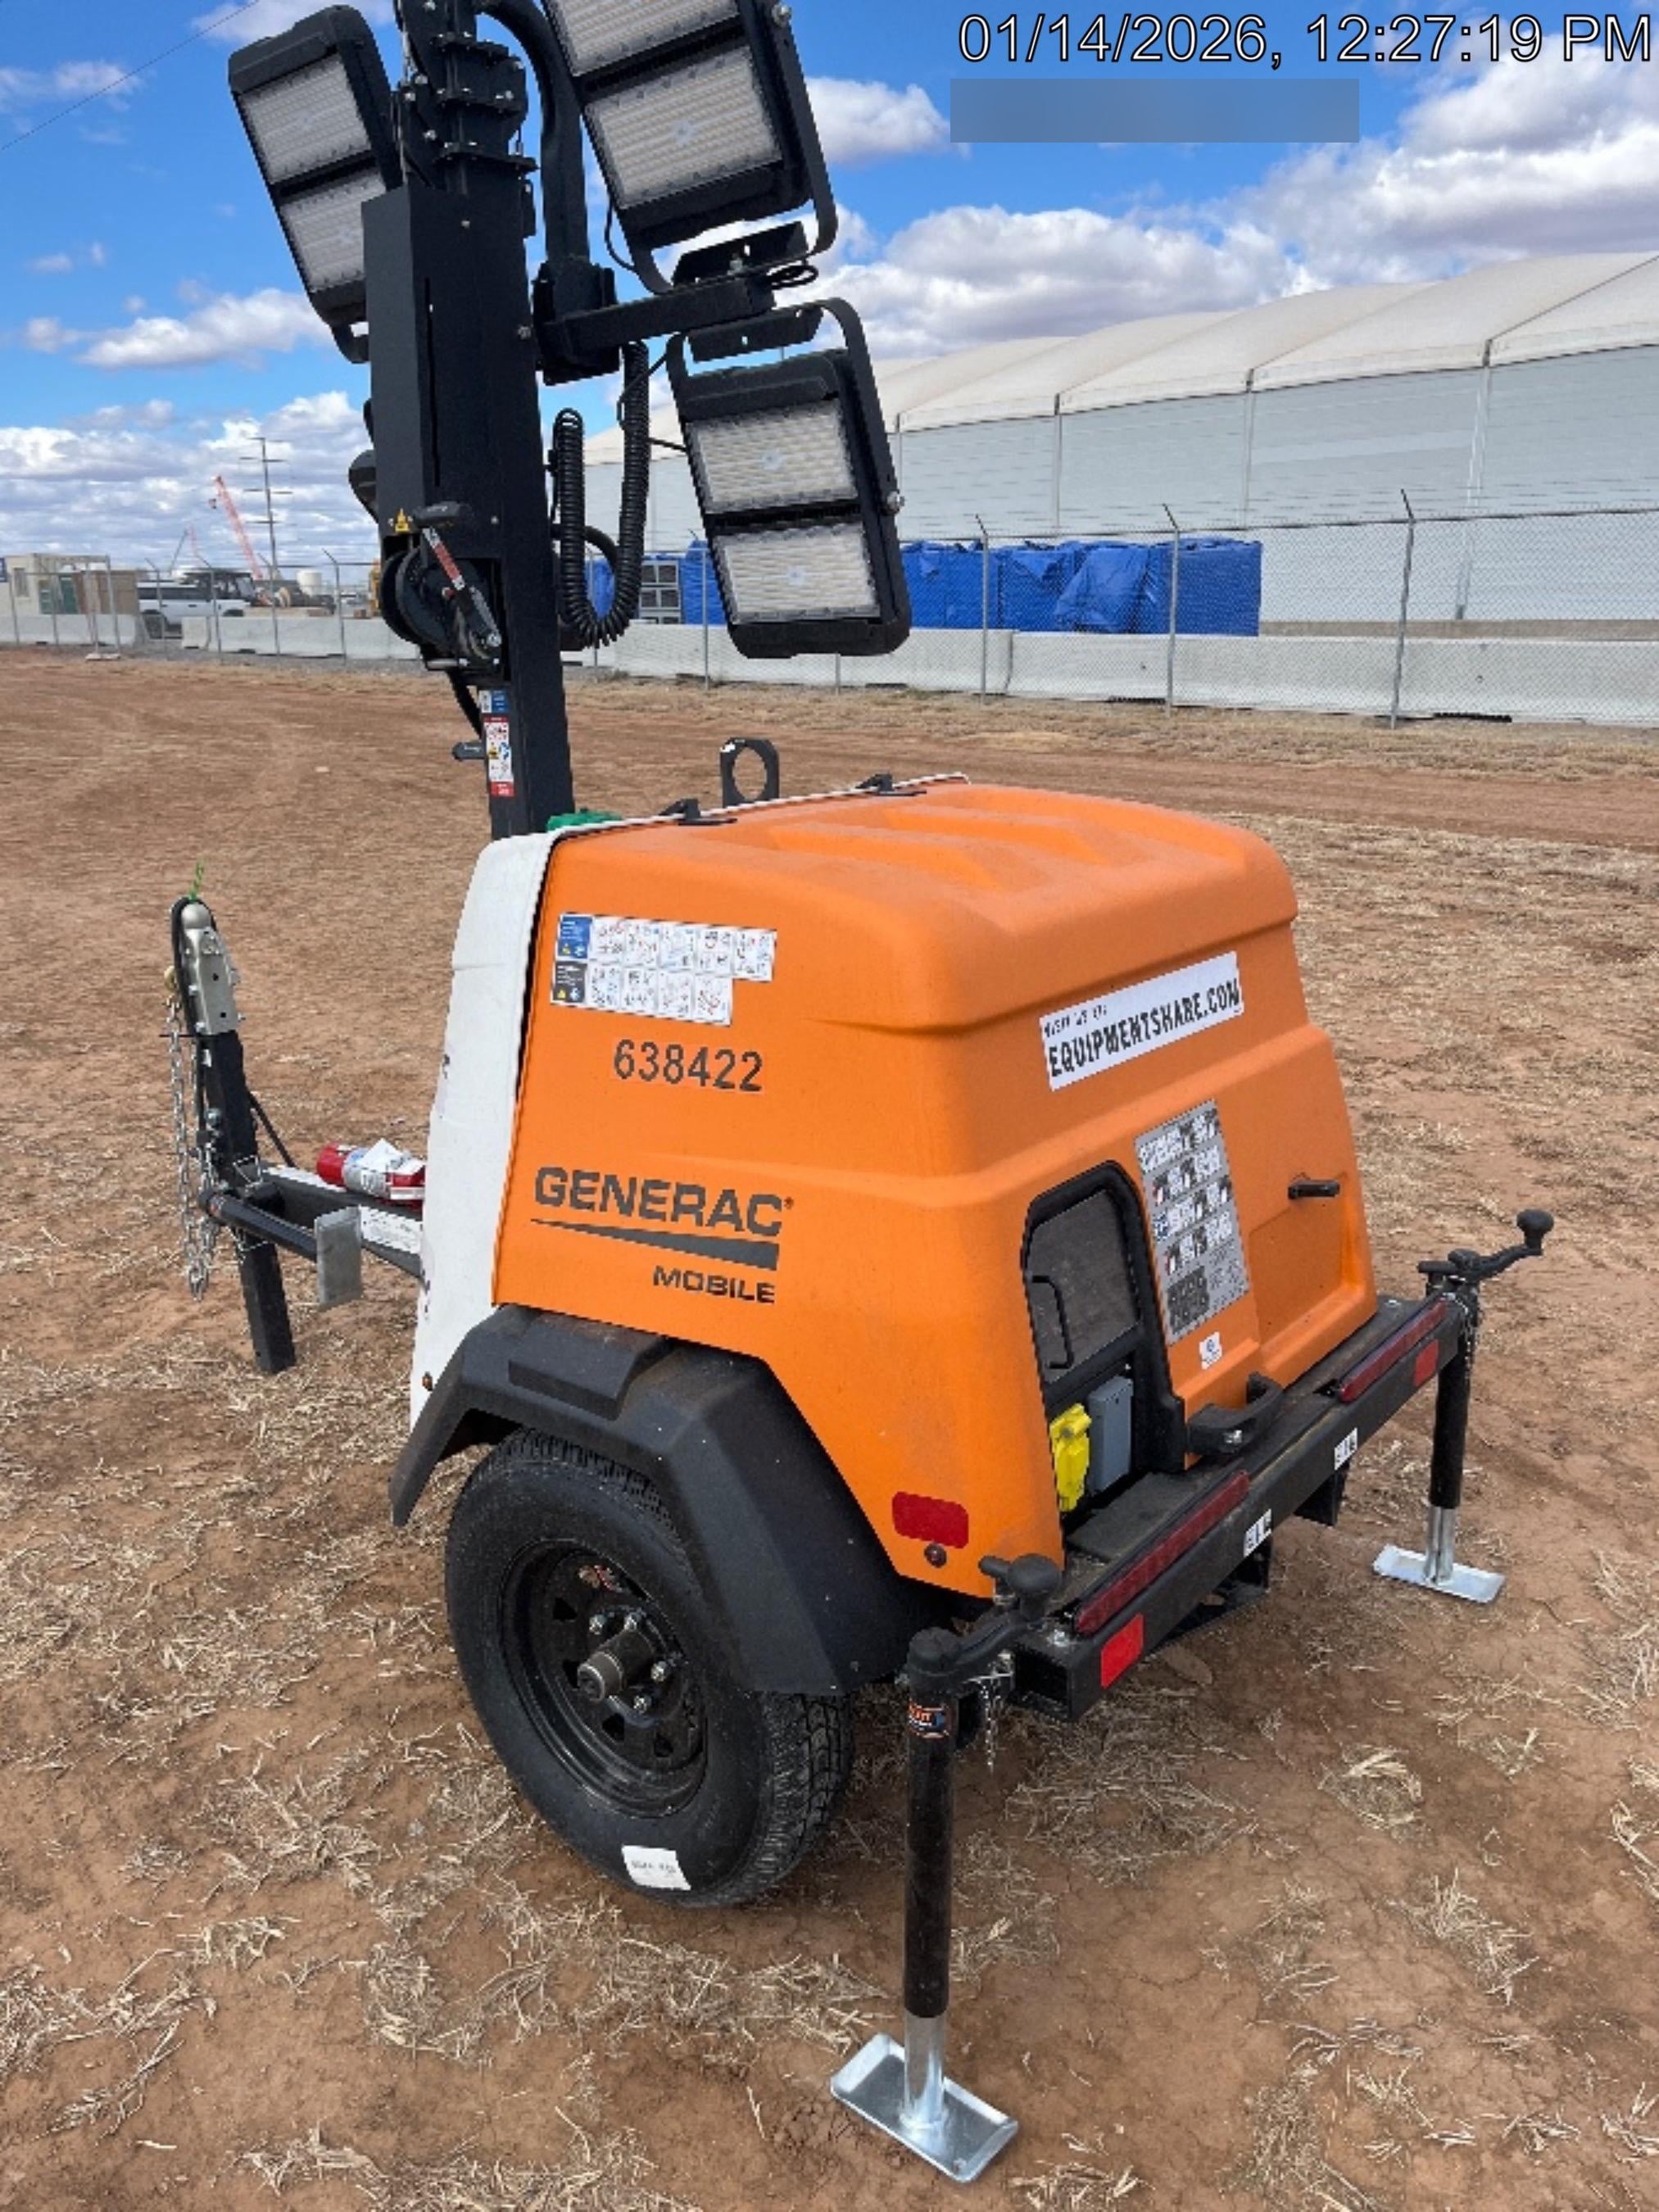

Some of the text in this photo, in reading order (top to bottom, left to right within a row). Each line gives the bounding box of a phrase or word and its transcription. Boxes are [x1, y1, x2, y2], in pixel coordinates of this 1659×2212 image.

[1049, 978, 1240, 1077] EQUIPMENTSHARE.COM
[614, 1039, 763, 1092] 638422
[535, 1167, 782, 1237] GENERAC
[653, 1265, 776, 1304] MOBILE
